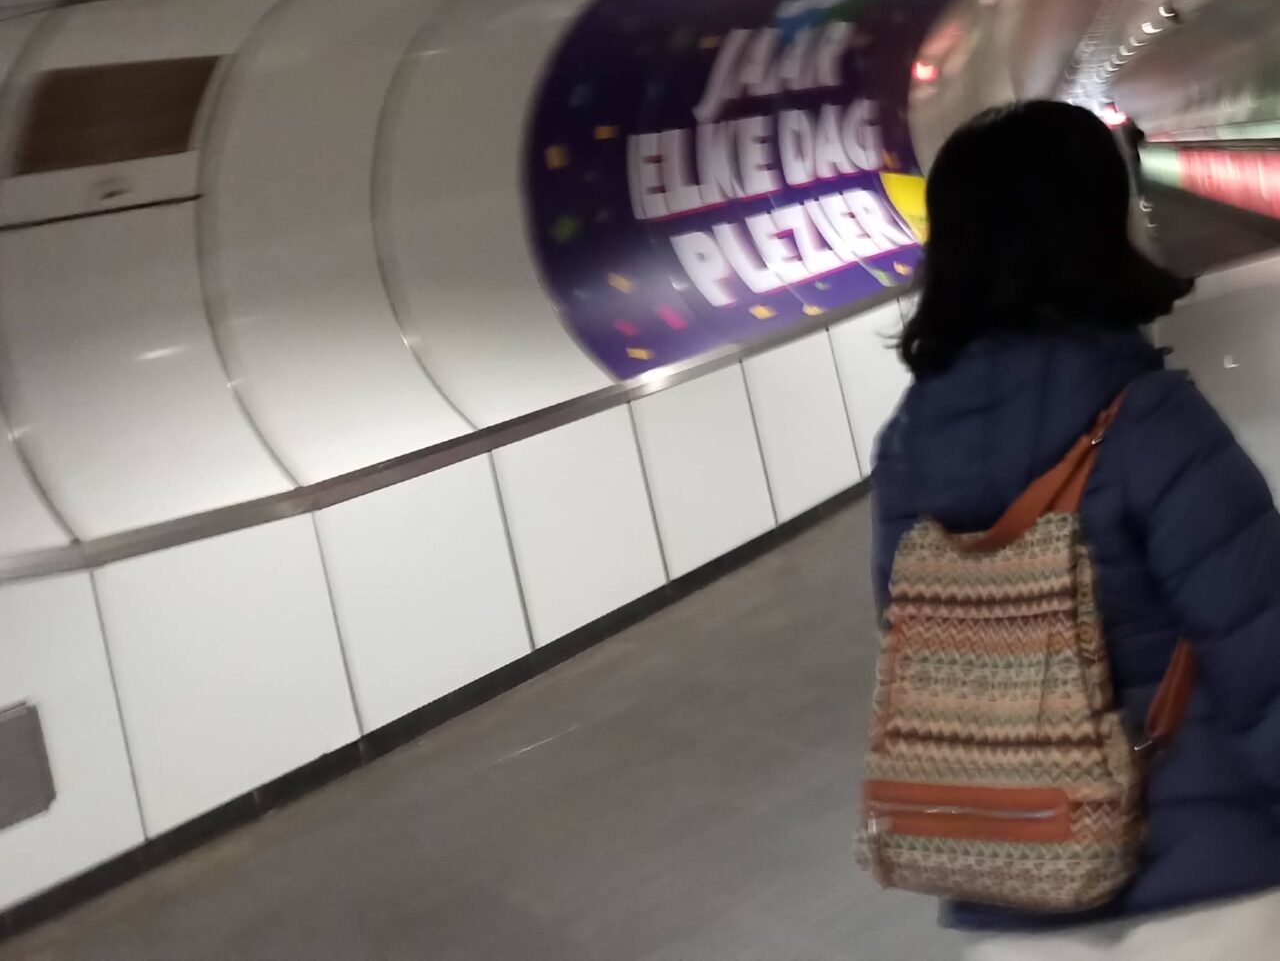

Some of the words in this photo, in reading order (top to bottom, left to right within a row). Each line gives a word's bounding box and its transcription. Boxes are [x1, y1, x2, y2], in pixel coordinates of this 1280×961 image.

[627, 115, 782, 220] ELKE
[779, 99, 885, 187] DAG
[670, 188, 918, 307] PLEZIER
